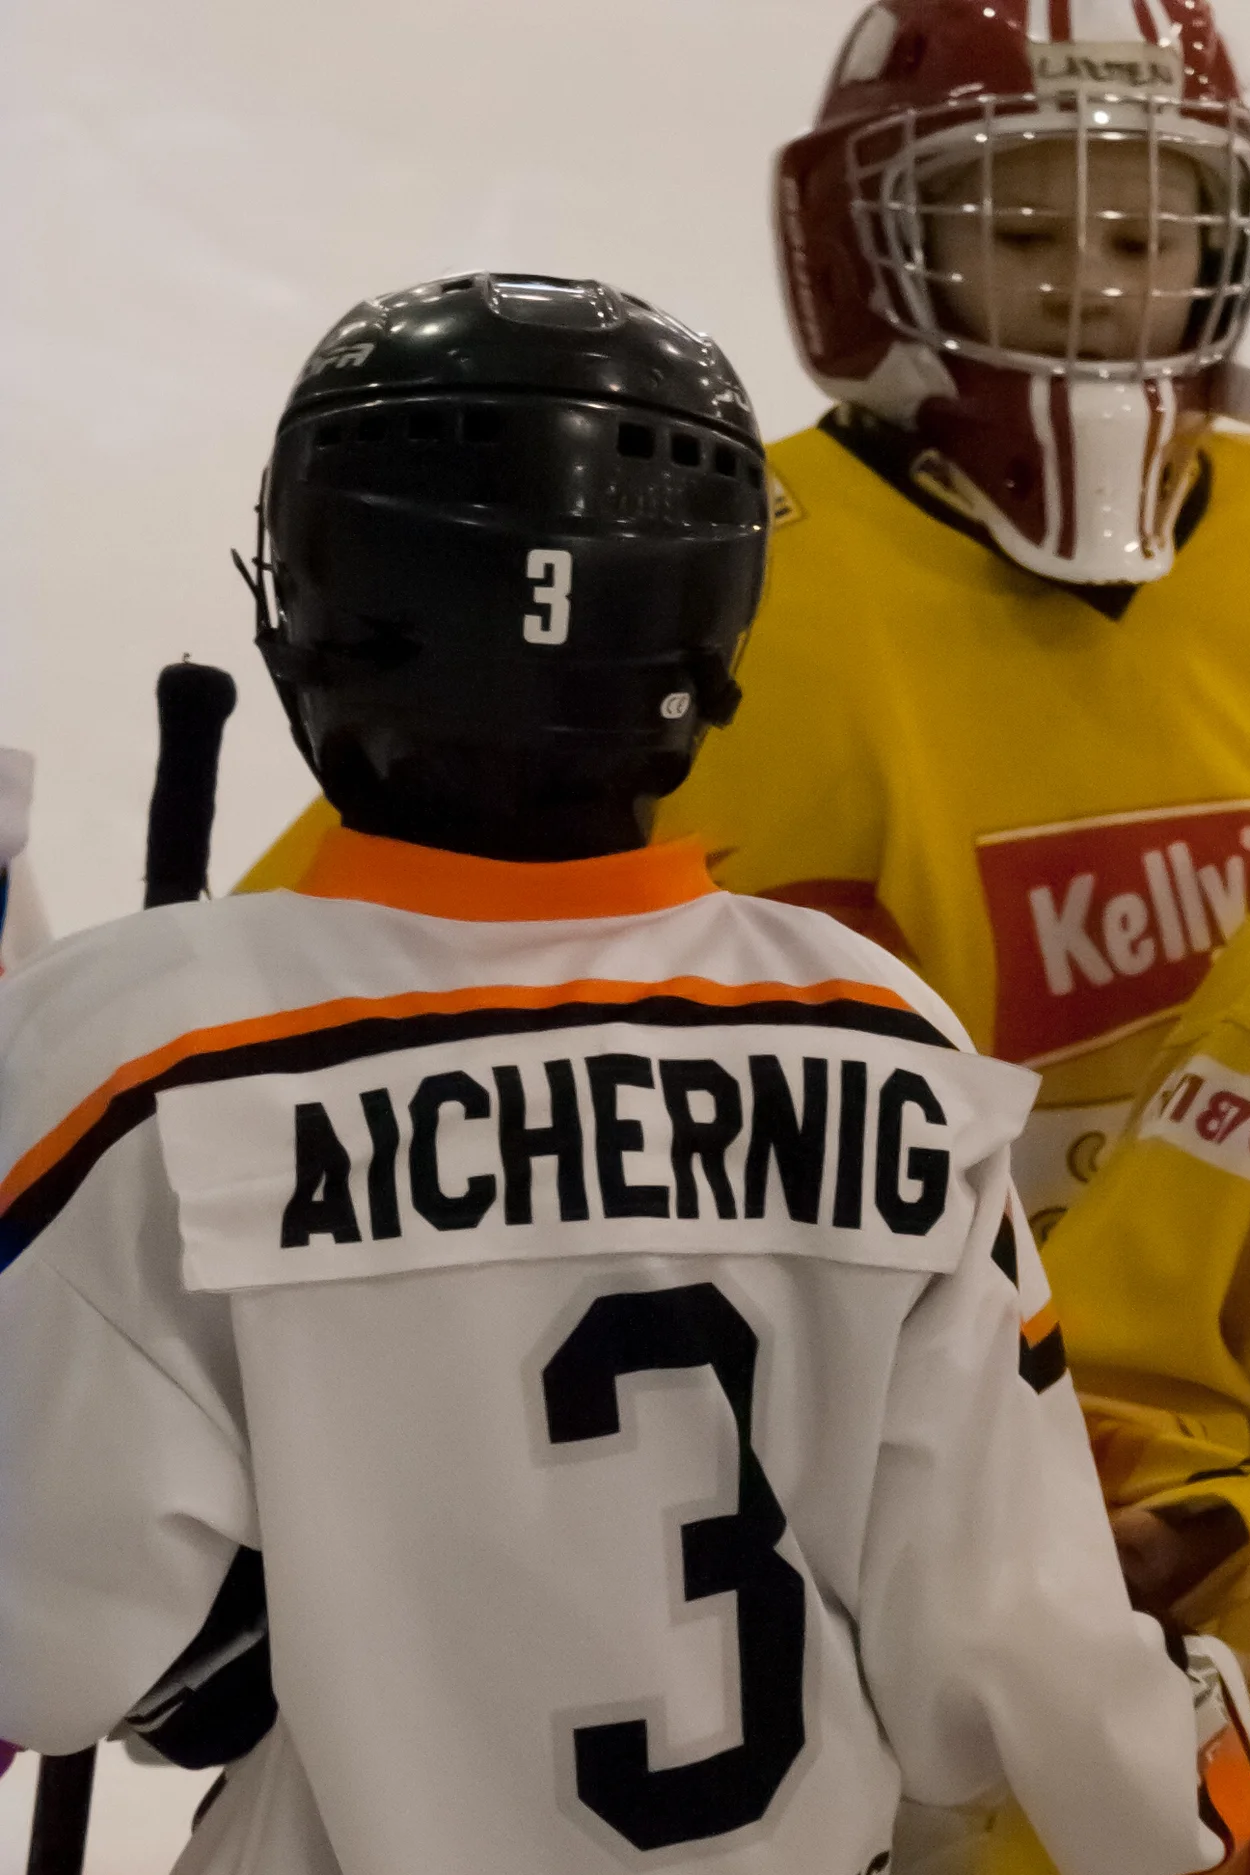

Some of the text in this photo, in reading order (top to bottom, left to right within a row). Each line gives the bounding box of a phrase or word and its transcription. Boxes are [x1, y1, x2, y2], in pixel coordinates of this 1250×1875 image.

[523, 549, 573, 645] 3
[280, 1053, 950, 1250] AICHERNIG
[542, 1282, 805, 1852] 3
